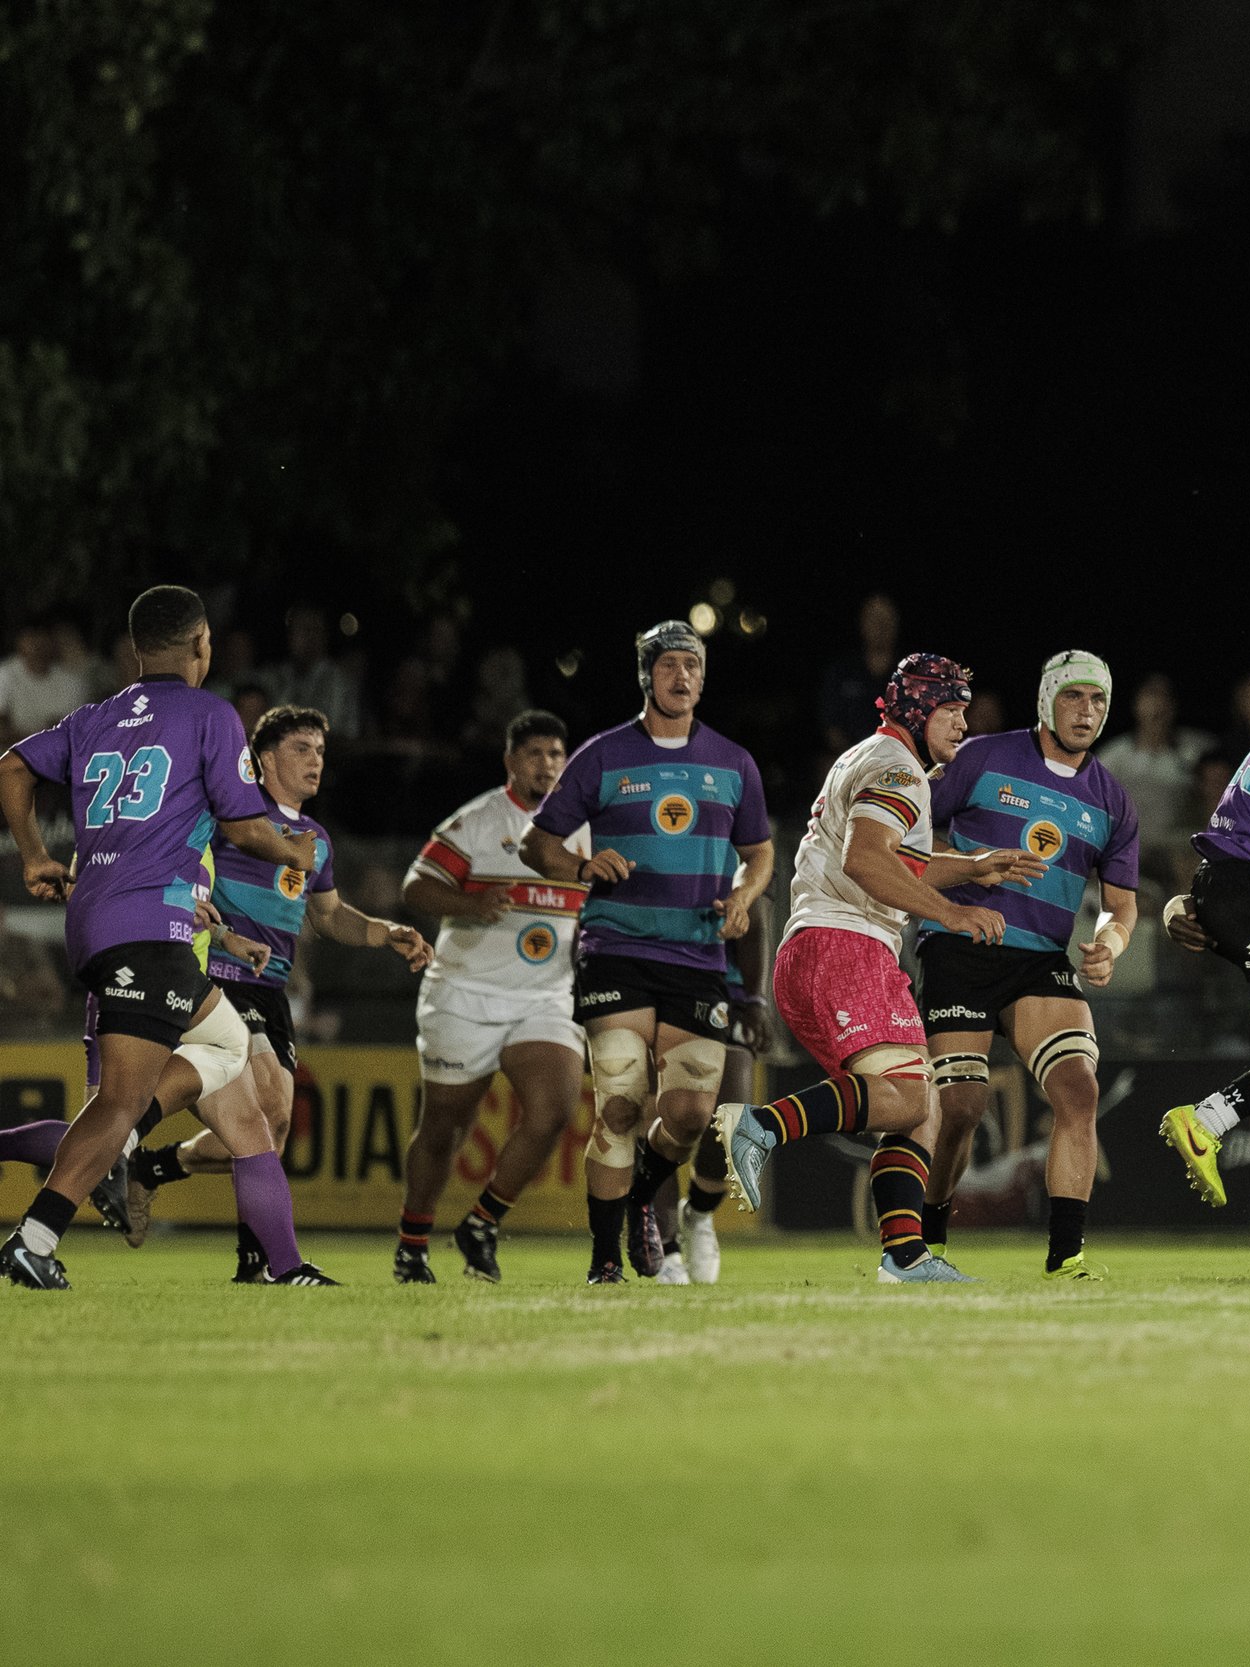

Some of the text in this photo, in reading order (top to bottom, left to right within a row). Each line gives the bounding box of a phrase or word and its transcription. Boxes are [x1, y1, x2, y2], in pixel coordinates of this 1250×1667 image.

[117, 713, 154, 728] SUZUKI
[83, 745, 172, 829] 23
[1000, 793, 1031, 810] STEERS
[528, 886, 565, 908] Tuks
[105, 987, 145, 1001] SUZUKI
[928, 1005, 986, 1022] SportPesa
[836, 1023, 868, 1042] SUZUKI
